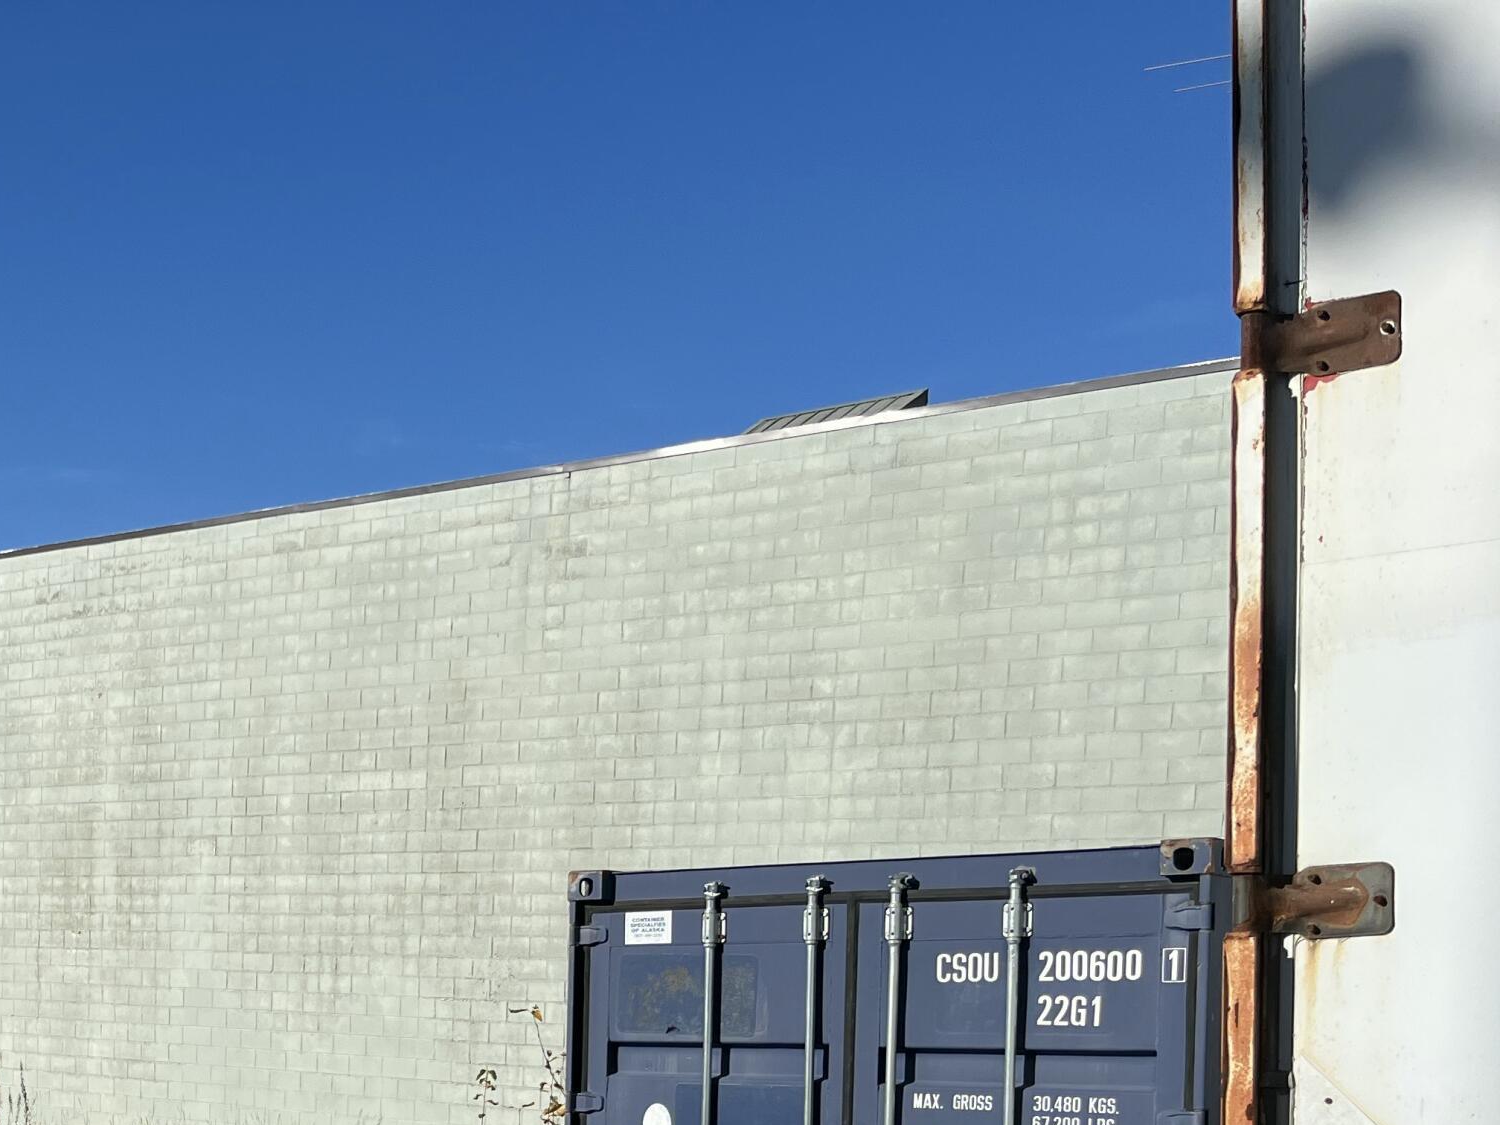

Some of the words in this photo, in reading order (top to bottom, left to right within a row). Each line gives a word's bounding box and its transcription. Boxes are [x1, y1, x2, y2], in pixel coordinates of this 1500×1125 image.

[936, 952, 999, 983] CSOU
[1038, 949, 1143, 982] 200600
[1165, 949, 1182, 982] 1
[1036, 995, 1102, 1027] 22G1
[912, 1093, 944, 1110] MAX.
[952, 1094, 993, 1111] GROSS
[1088, 1097, 1120, 1115] KGS.
